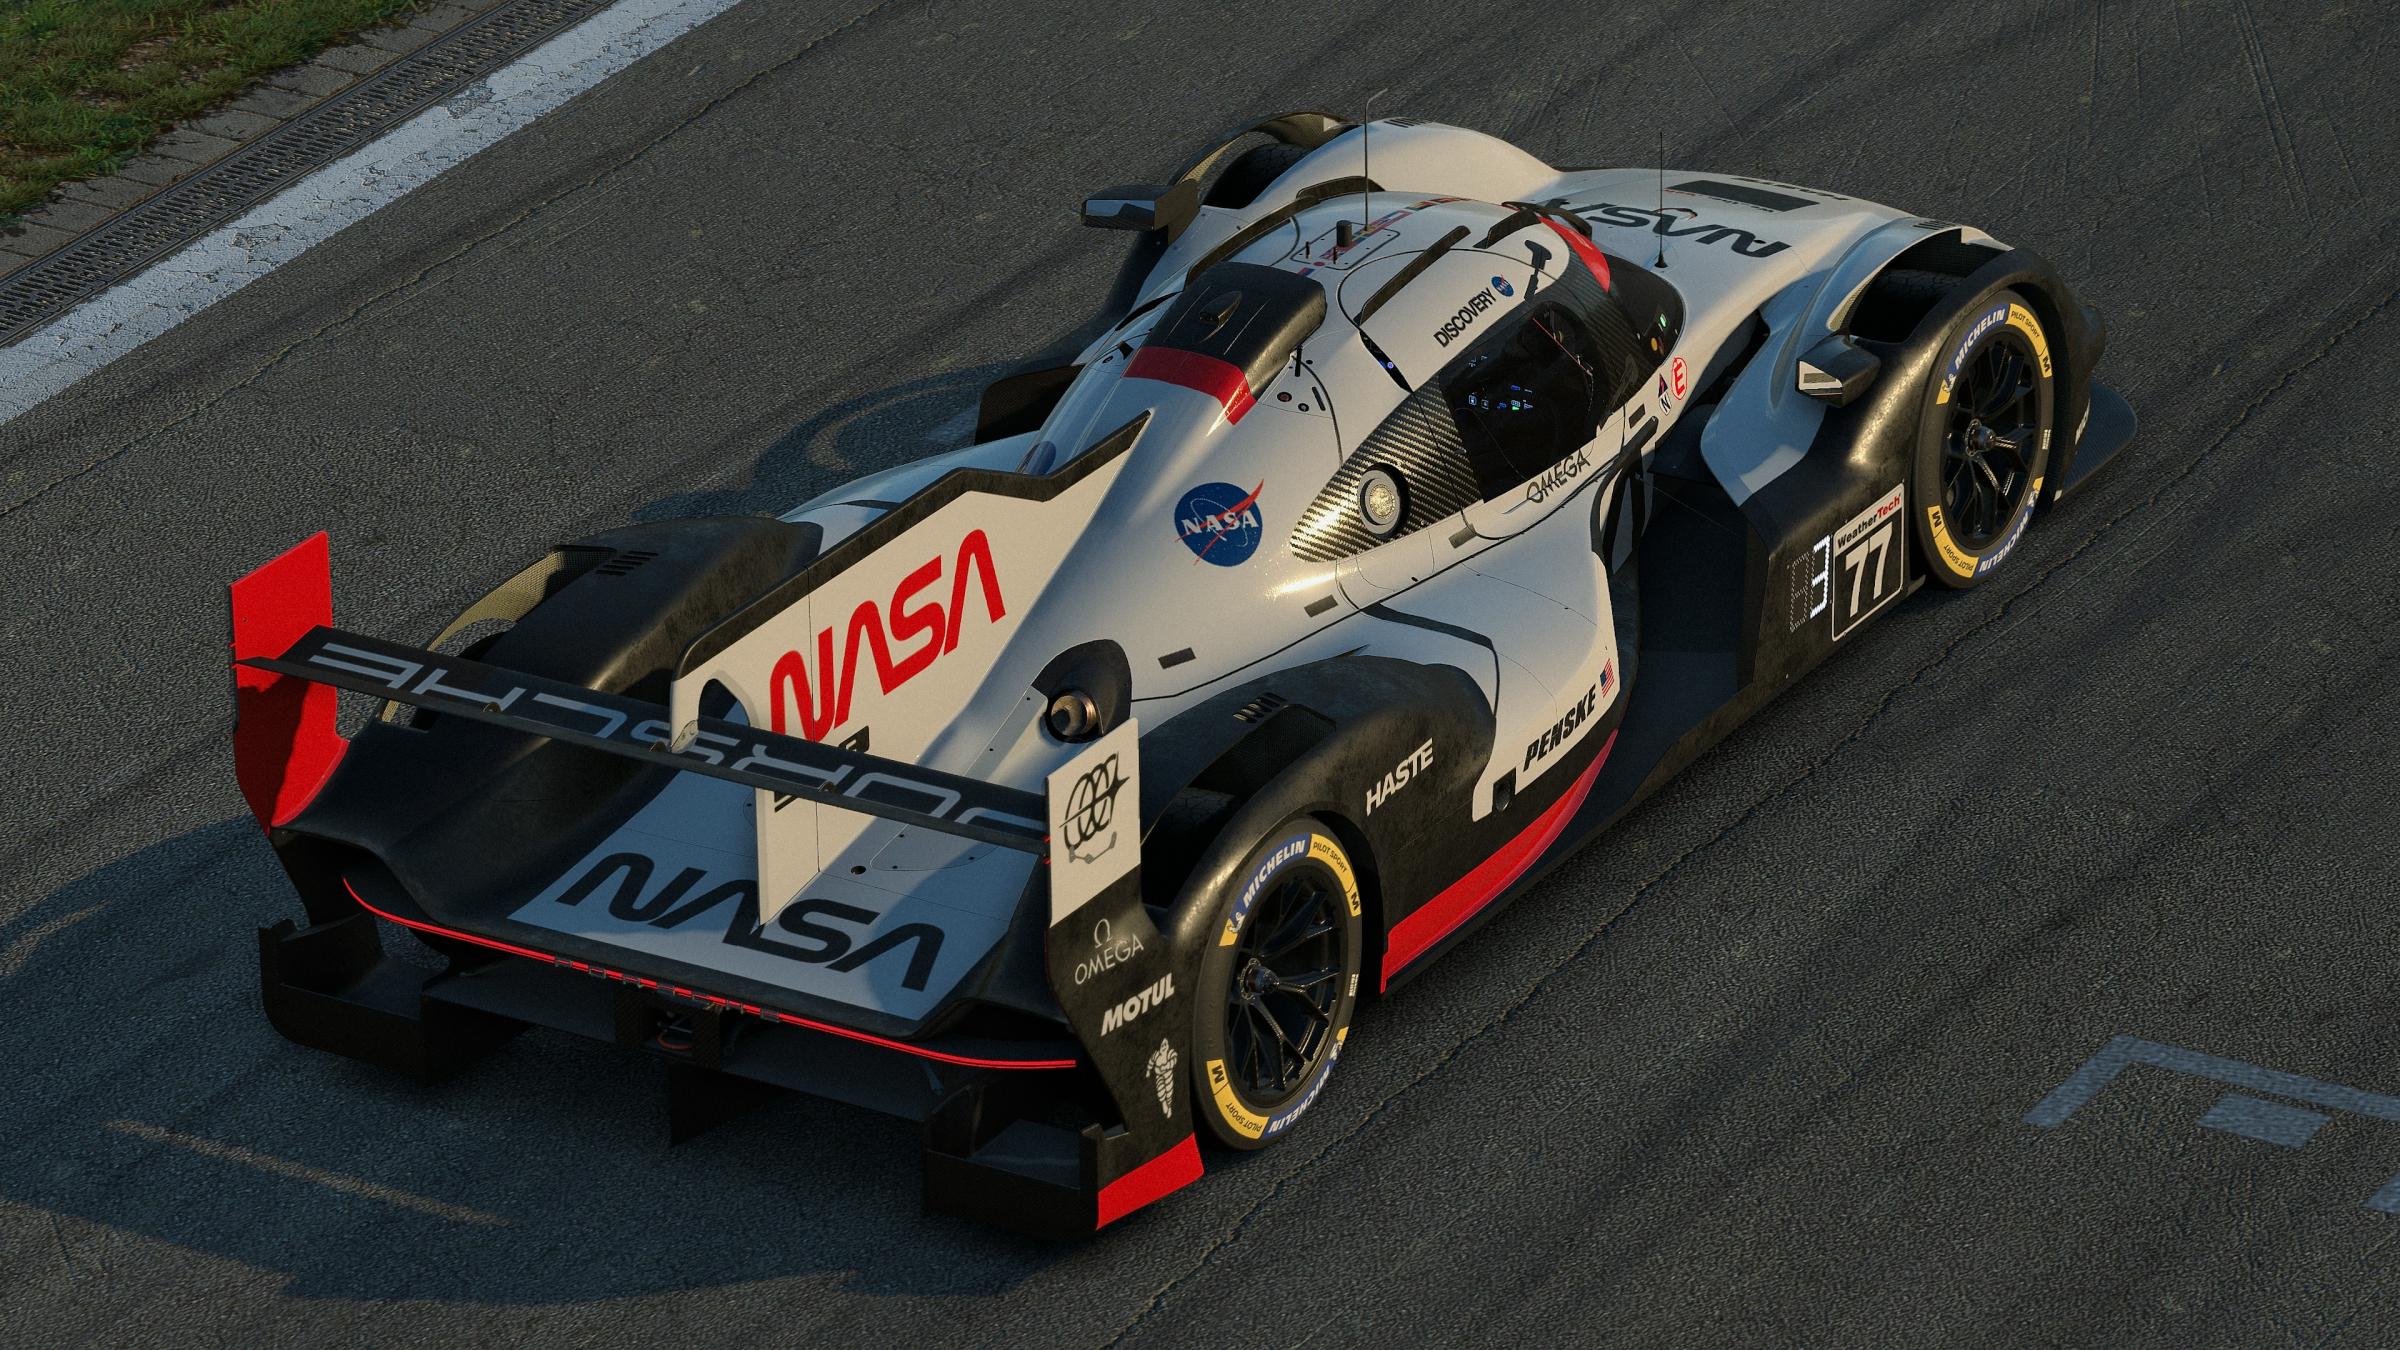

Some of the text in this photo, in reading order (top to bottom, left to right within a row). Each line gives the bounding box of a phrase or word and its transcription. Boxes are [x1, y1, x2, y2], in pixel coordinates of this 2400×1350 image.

[1433, 287, 1497, 347] DISCOVERY
[1954, 309, 2006, 370] MICHELIN
[2011, 310, 2040, 338] PILOT SPORT
[1526, 449, 1591, 504] OMEGA
[1181, 510, 1259, 535] NASA
[1837, 495, 1901, 549] WeatherTech
[1979, 511, 2029, 573] MICHELIN
[1845, 521, 1893, 618] 77
[1943, 544, 1974, 572] PILOT SPORT
[770, 529, 1006, 743] NASA
[1522, 683, 1597, 772] PENSKE
[1366, 737, 1434, 817] HASTE
[1242, 839, 1306, 908] MICHELIN
[1313, 841, 1347, 873] PILOT SPORT
[555, 852, 945, 992] NASA
[1074, 934, 1144, 985] OMEGA
[1101, 973, 1175, 1037] MOTUL
[1226, 1102, 1263, 1132] PILOT SPORT
[1268, 1065, 1330, 1133] MICHELIN
